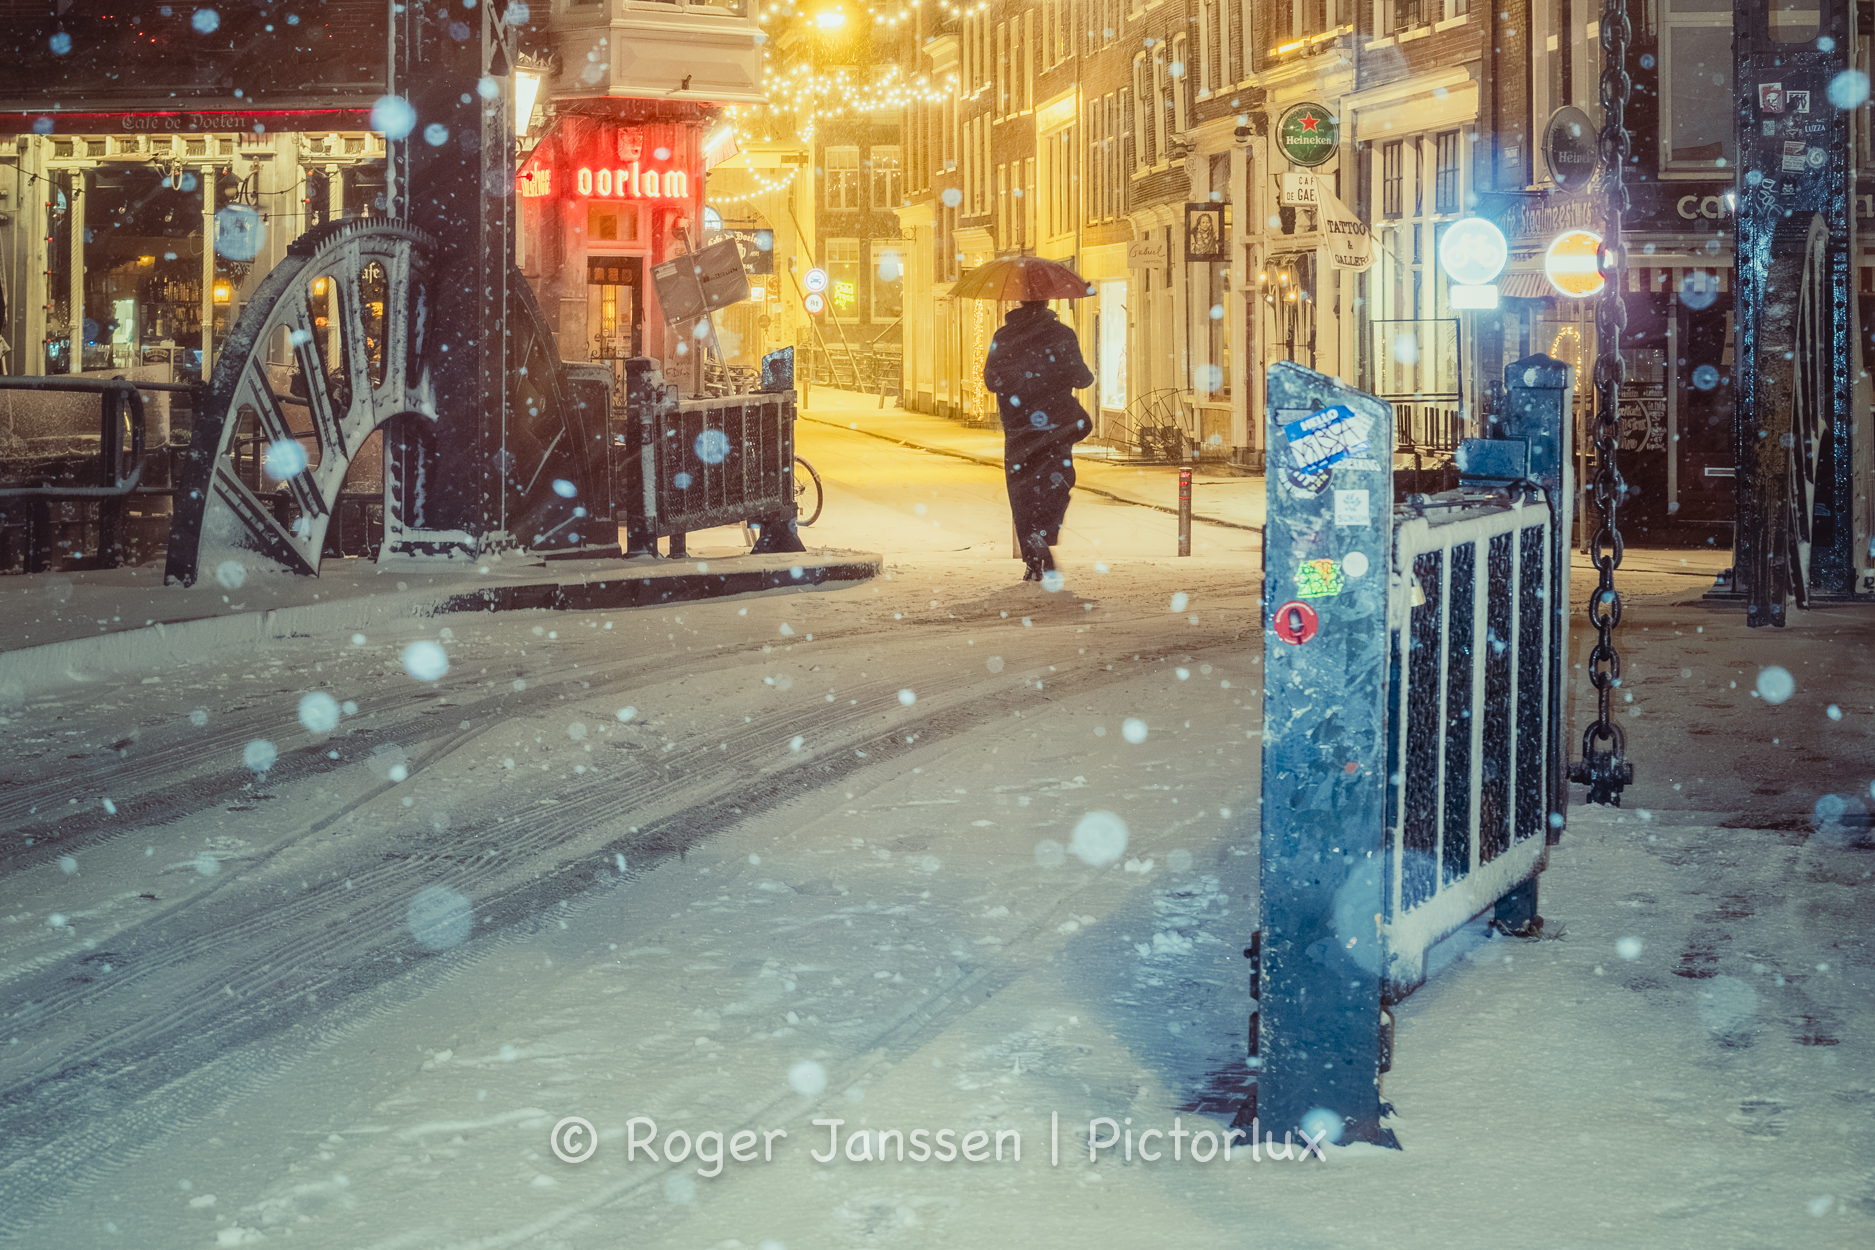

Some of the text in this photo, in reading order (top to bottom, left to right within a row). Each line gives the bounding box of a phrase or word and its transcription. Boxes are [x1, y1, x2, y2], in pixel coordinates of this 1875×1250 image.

[165, 117, 181, 129] de
[188, 113, 246, 128] Doelen
[1286, 135, 1332, 145] Heineken
[1558, 151, 1592, 164] Heine
[578, 161, 689, 198] oorlam
[1298, 177, 1314, 185] CAF
[1286, 188, 1318, 201] DE GAE
[1327, 220, 1367, 236] TATTOO
[1347, 240, 1354, 250] &
[1335, 252, 1371, 267] GALLERY
[362, 262, 380, 284] afe
[1300, 409, 1339, 432] HELLO
